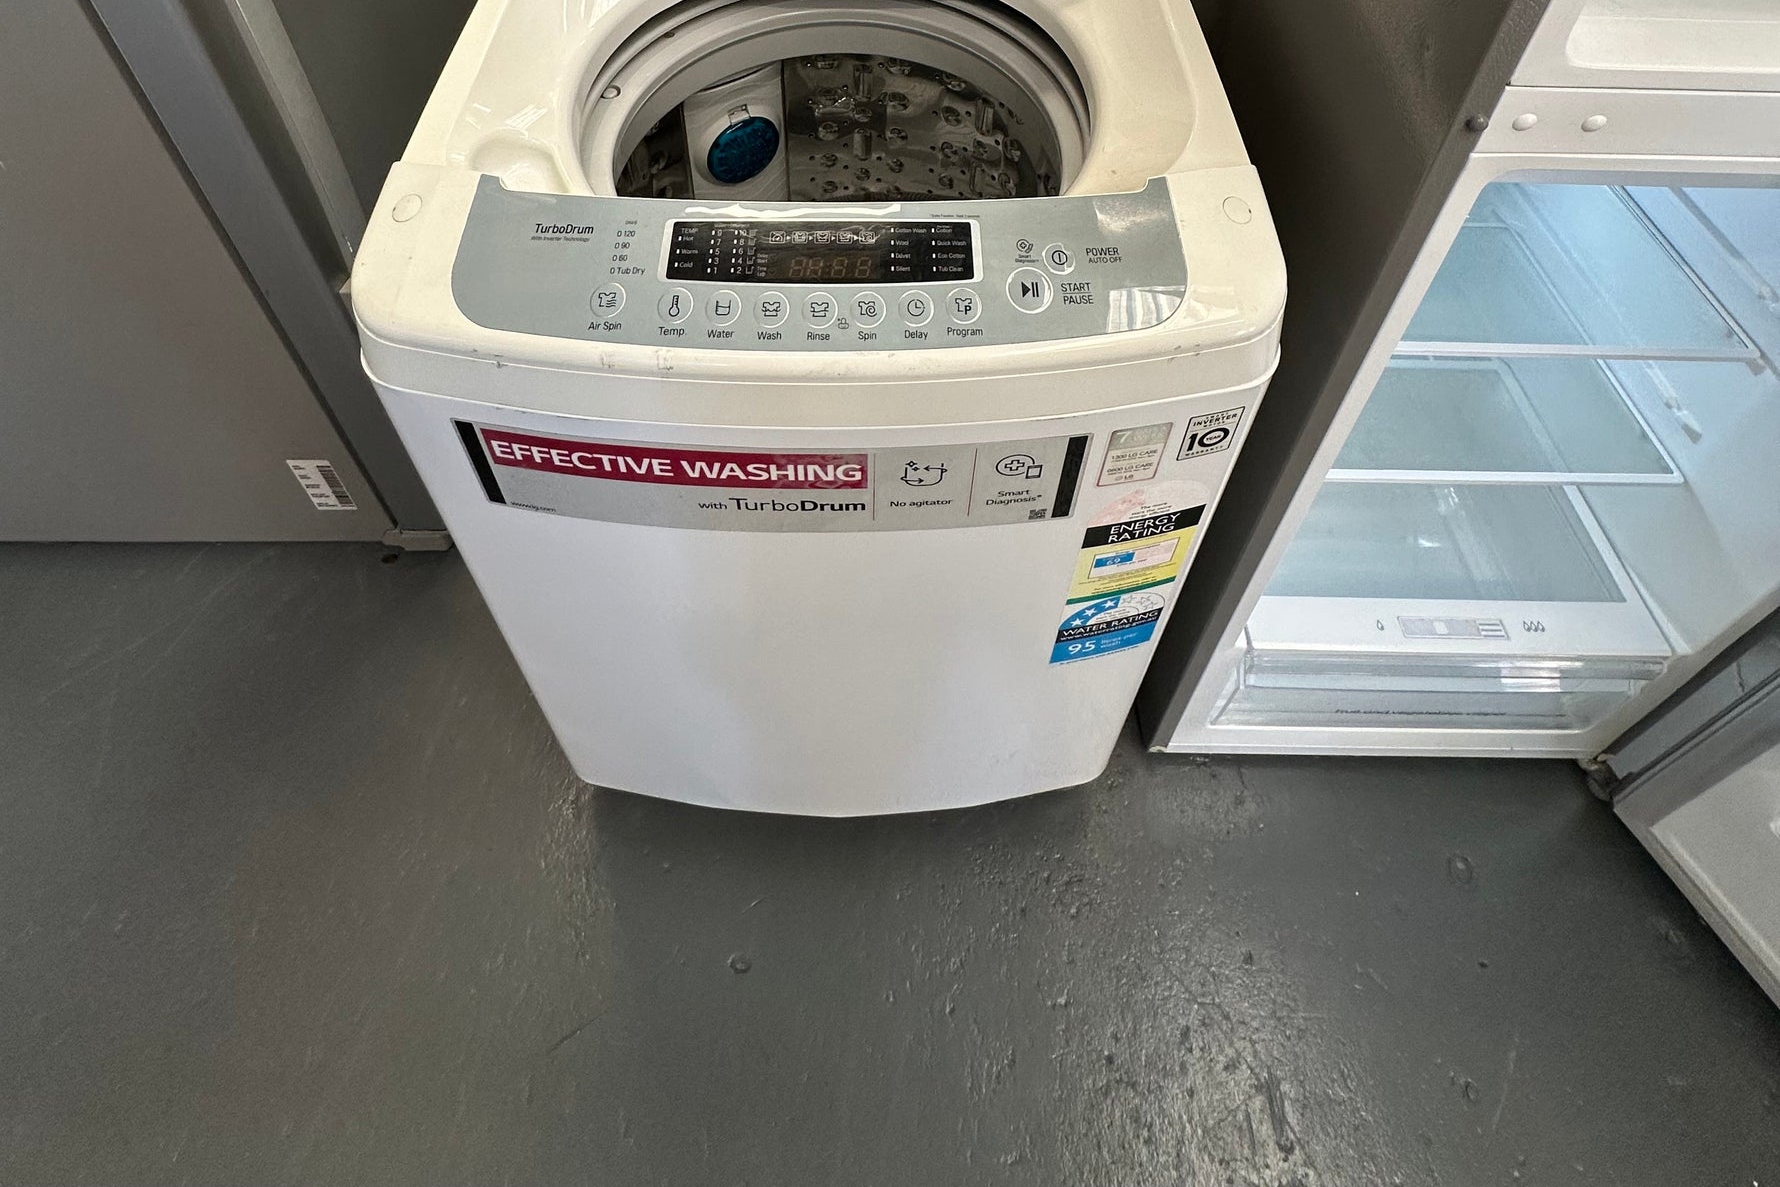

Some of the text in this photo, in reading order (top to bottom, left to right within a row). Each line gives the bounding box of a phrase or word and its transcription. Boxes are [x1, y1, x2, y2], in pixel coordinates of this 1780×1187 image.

[535, 223, 594, 235] TurboDrum
[1085, 247, 1119, 256] POWER
[1112, 256, 1122, 264] OFF
[617, 267, 646, 276] Tub Dry
[736, 266, 742, 274] 2
[1060, 282, 1091, 292] START
[1063, 295, 1094, 305] PAUSE
[588, 321, 622, 331] Air Spin
[707, 329, 735, 339] Water
[757, 331, 782, 340] Wash
[806, 332, 830, 341] Rinse
[858, 331, 877, 342] Spin
[904, 330, 928, 340] Delay
[947, 327, 983, 337] Program
[1193, 413, 1238, 427] INVERTER
[1187, 427, 1230, 452] 10
[490, 439, 863, 481] EFFECTIVE WASHING
[997, 489, 1031, 497] Smart
[698, 497, 866, 512] with TurboDrum
[890, 499, 952, 509] No agitator
[1110, 513, 1181, 535] ENERGY
[1107, 523, 1176, 543] RATING
[1063, 622, 1107, 636] WATER
[1111, 610, 1158, 627] RATING
[1068, 640, 1096, 655] 95
